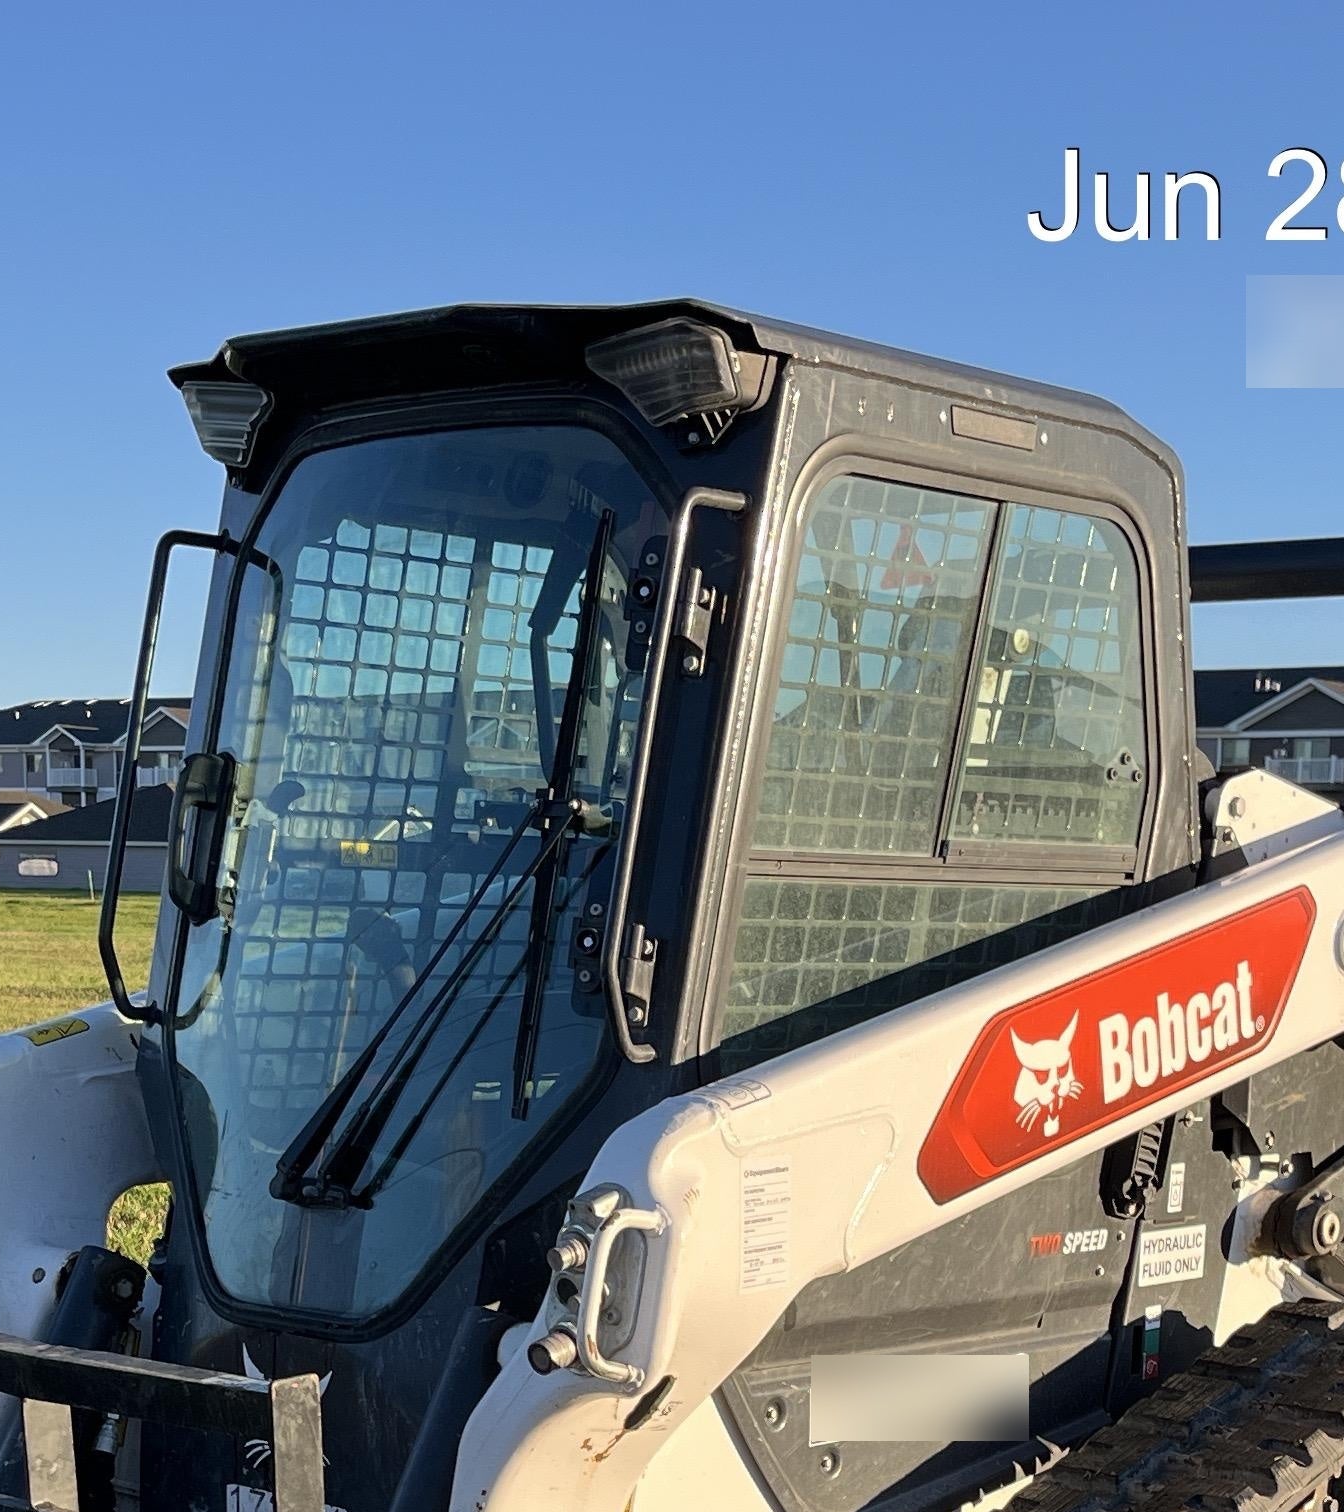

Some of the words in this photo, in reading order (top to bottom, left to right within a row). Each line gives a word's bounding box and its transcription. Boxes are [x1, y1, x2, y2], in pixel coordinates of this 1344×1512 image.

[1098, 959, 1256, 1105] Bobcat
[1030, 1231, 1063, 1257] TWO
[1062, 1228, 1109, 1255] SPEED
[1142, 1232, 1203, 1255] HYDRAULIC
[1142, 1259, 1173, 1280] FLUID
[1174, 1255, 1202, 1275] ONLY
